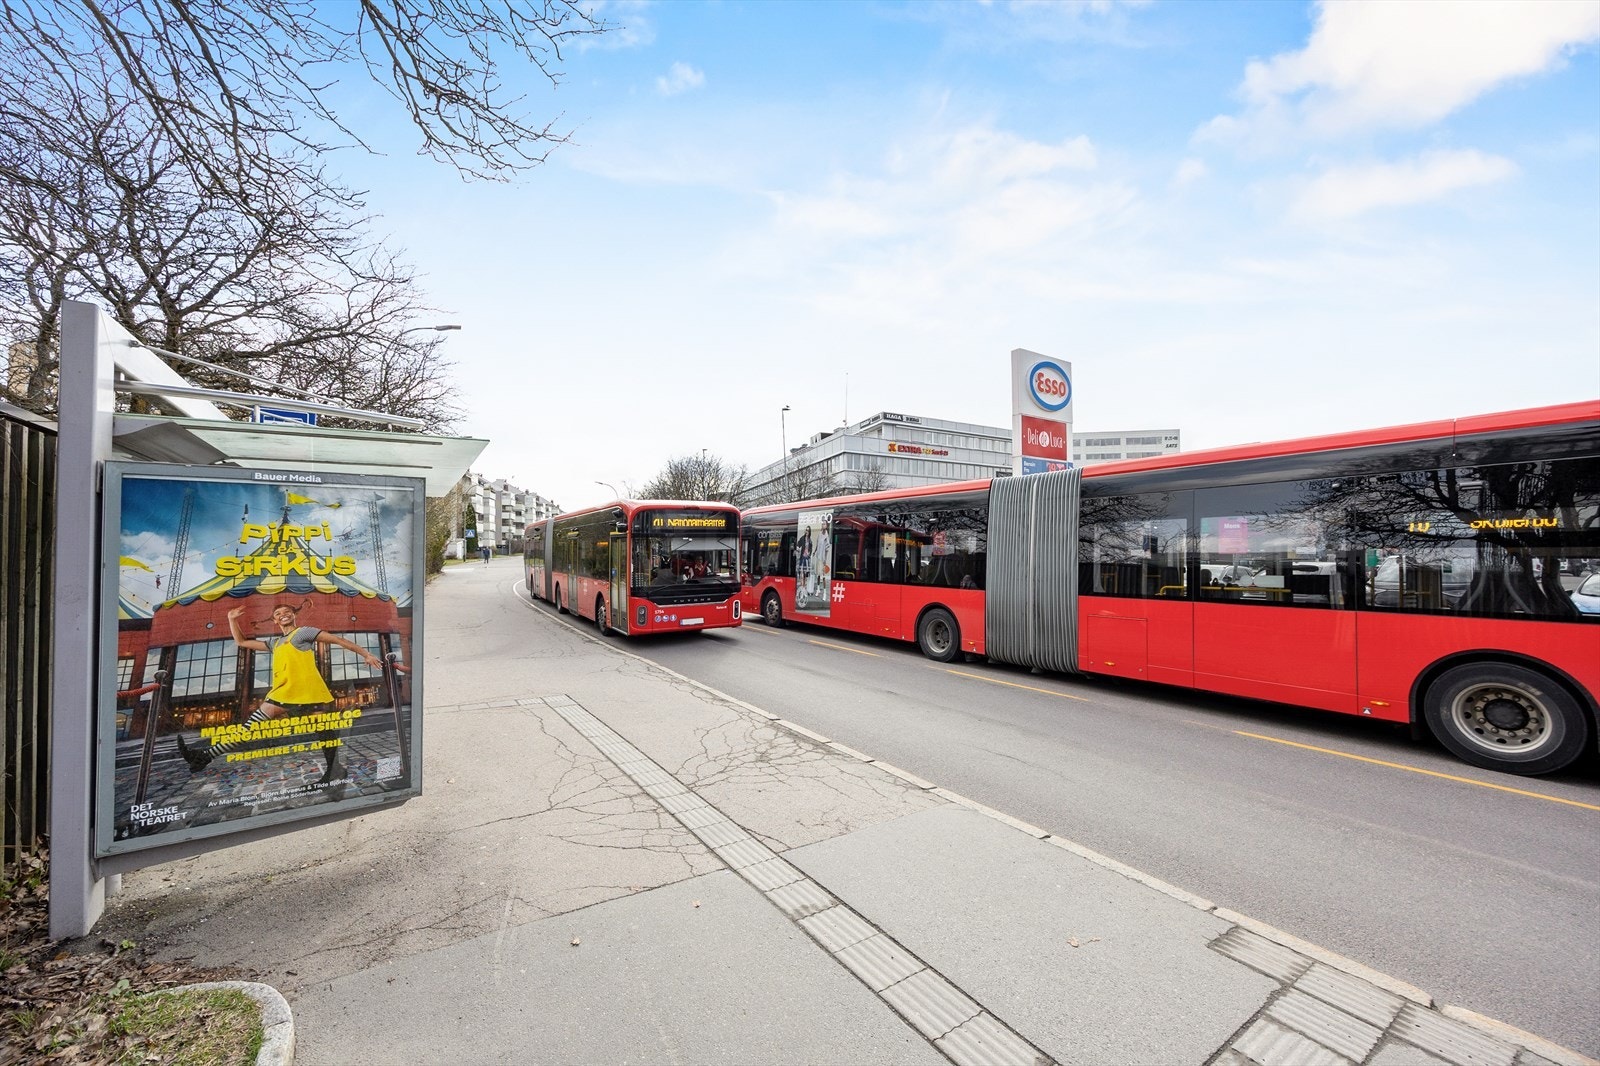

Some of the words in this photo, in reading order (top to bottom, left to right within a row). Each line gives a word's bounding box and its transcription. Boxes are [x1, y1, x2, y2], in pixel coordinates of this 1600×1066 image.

[1027, 427, 1039, 446] Deli
[1049, 431, 1063, 448] Luca
[254, 472, 288, 482] Bauer
[288, 473, 322, 484] Media
[250, 711, 341, 732] AKROBATIKK
[342, 709, 362, 720] OG
[211, 725, 292, 746] FENGANDE
[293, 718, 353, 736] MUSIKK!
[226, 745, 290, 763] PREMIERE
[310, 738, 344, 751] APRIL
[130, 802, 153, 813] DET
[130, 806, 178, 821] NORSKE
[139, 811, 188, 827] TEATRET
